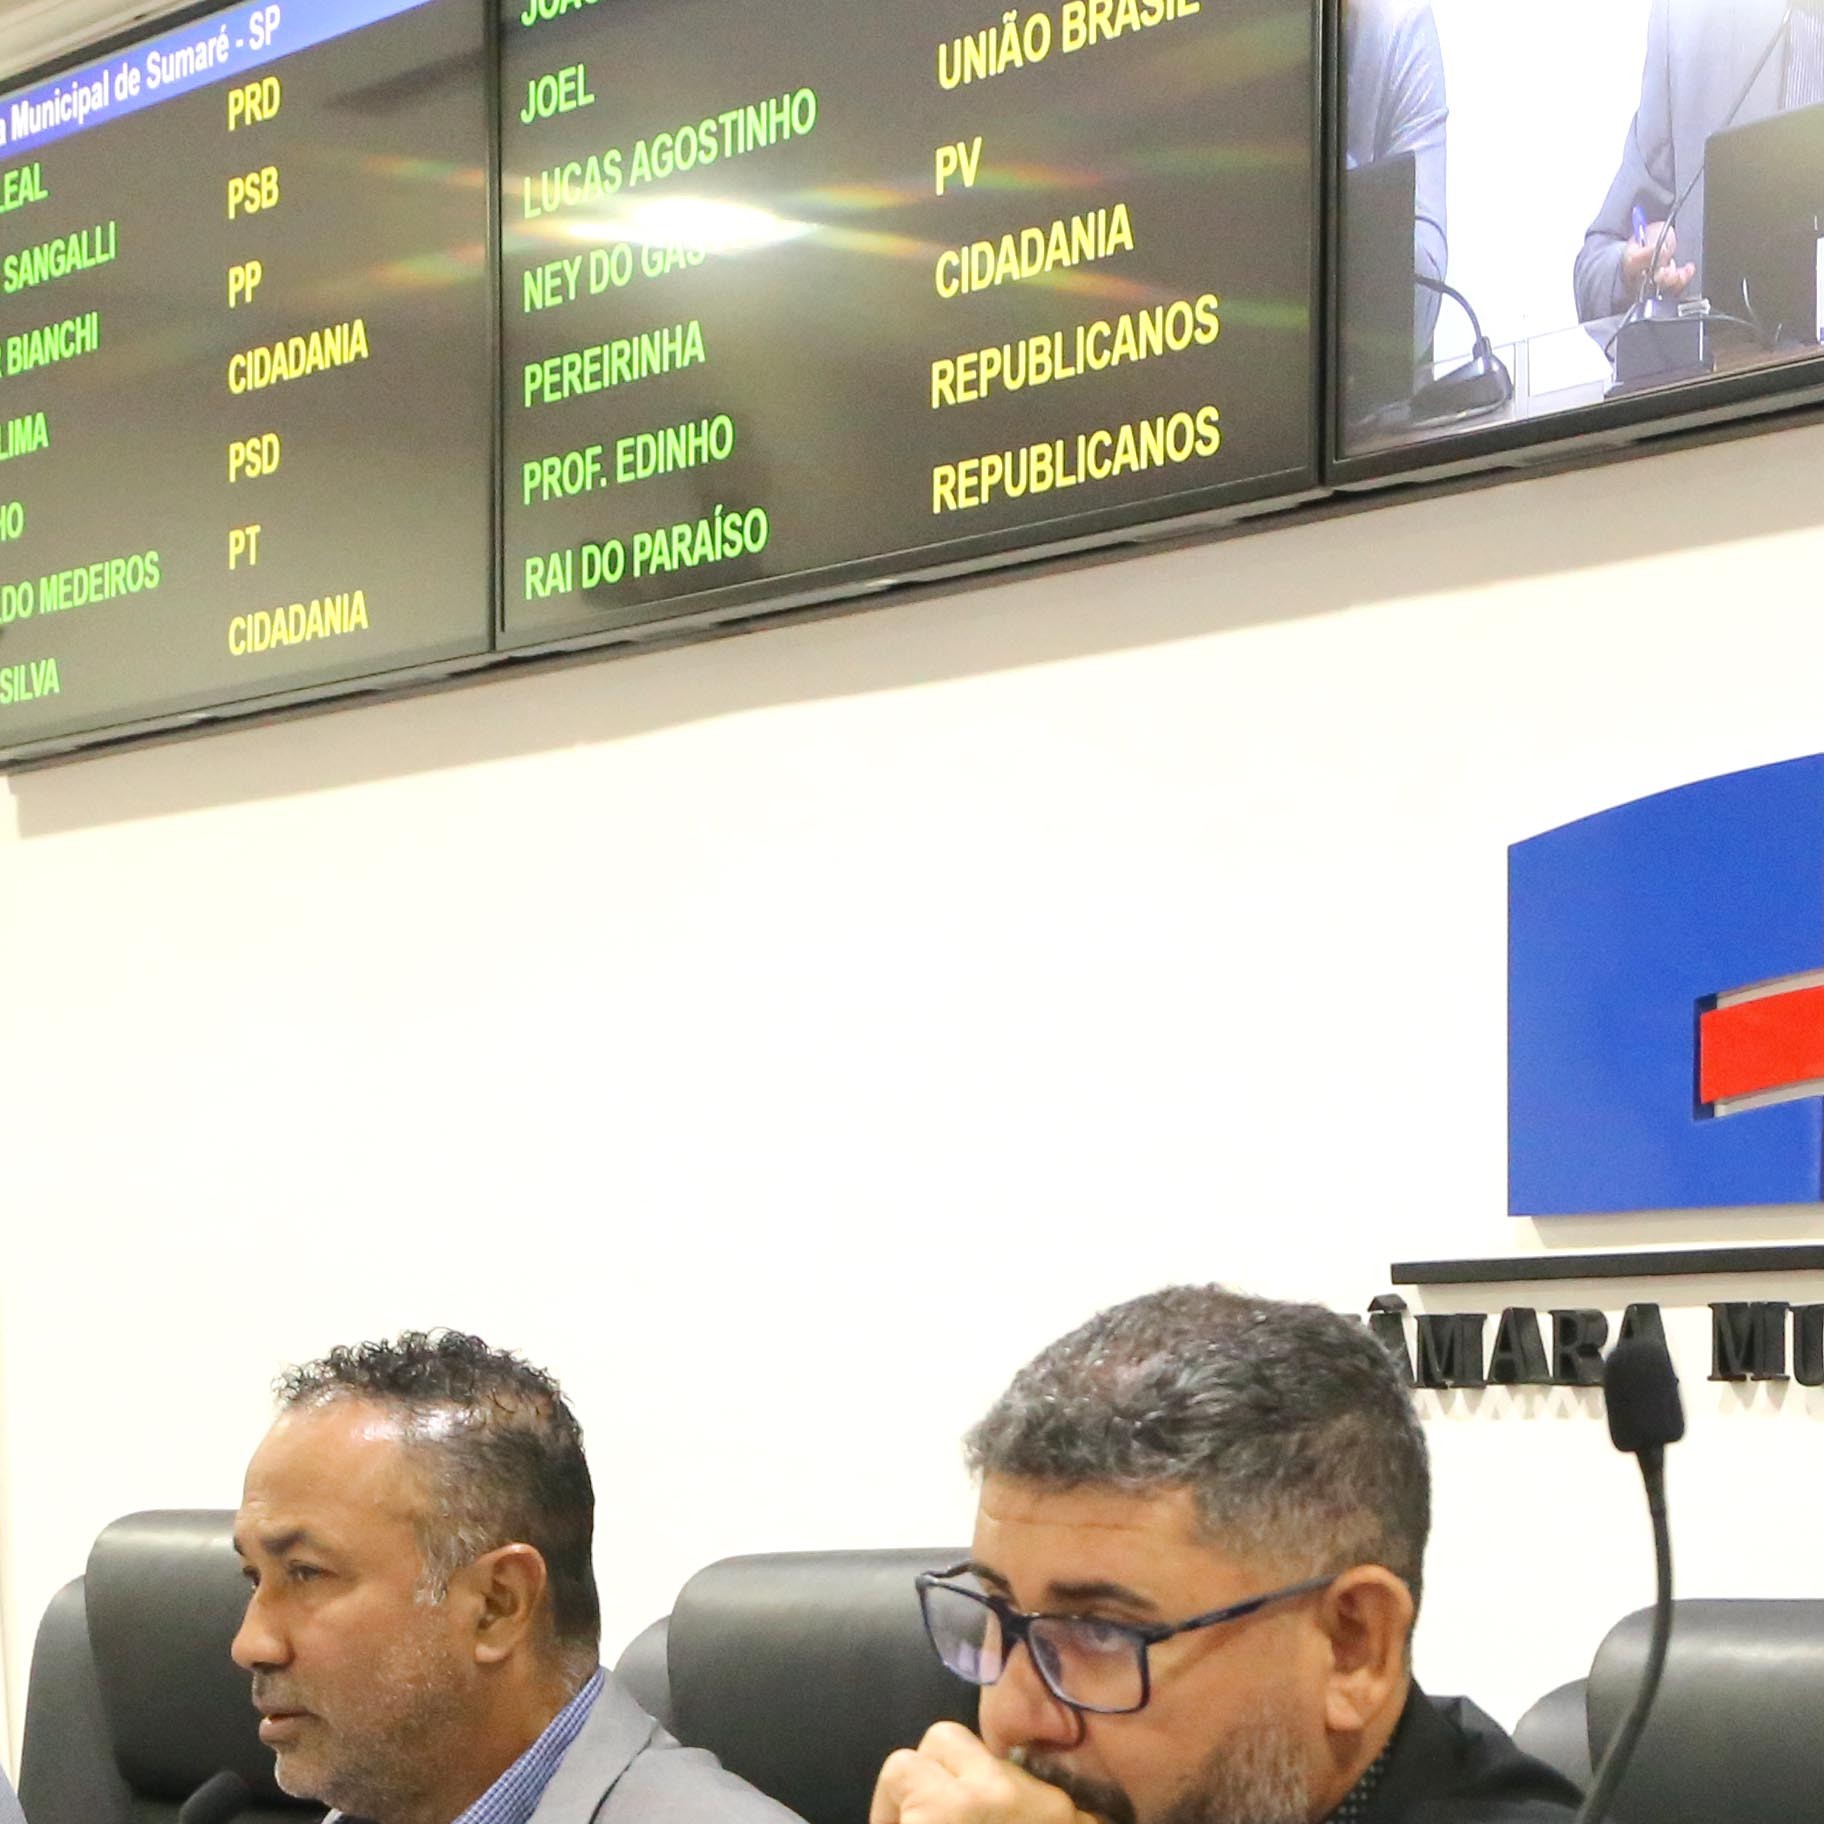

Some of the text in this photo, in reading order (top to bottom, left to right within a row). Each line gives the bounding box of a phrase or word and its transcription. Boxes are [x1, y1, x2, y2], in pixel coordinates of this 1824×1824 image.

[11, 70, 109, 141] Municipal
[114, 63, 140, 101] de
[146, 25, 230, 89] Sumaré
[249, 4, 281, 50] SP
[938, 9, 1052, 89] UNIÃO
[228, 76, 281, 131] PRD
[520, 63, 596, 124] JOEL
[524, 87, 817, 219] LUCAS AGOSTINHO
[936, 136, 983, 196] PV
[228, 166, 280, 220] PSB
[3, 221, 117, 294] SANGALLI
[228, 260, 263, 308] PP
[523, 254, 582, 313] NEY
[589, 242, 633, 295] DO
[935, 203, 1135, 298] CIDADANIA
[6, 311, 99, 376] BIANCHI
[228, 318, 369, 395] CIDADANIA
[525, 320, 705, 408] PEREIRINHA
[931, 294, 1219, 409] REPUBLICANOS
[228, 432, 281, 483] PSD
[524, 415, 734, 505] PROF. EDINHO
[932, 406, 1221, 515] REPUBLICANOS
[39, 550, 161, 614] MEDEIROS
[228, 524, 261, 570] PT
[526, 504, 769, 600] RAI DO PARAÍSO
[228, 589, 368, 656] CIDADANIA
